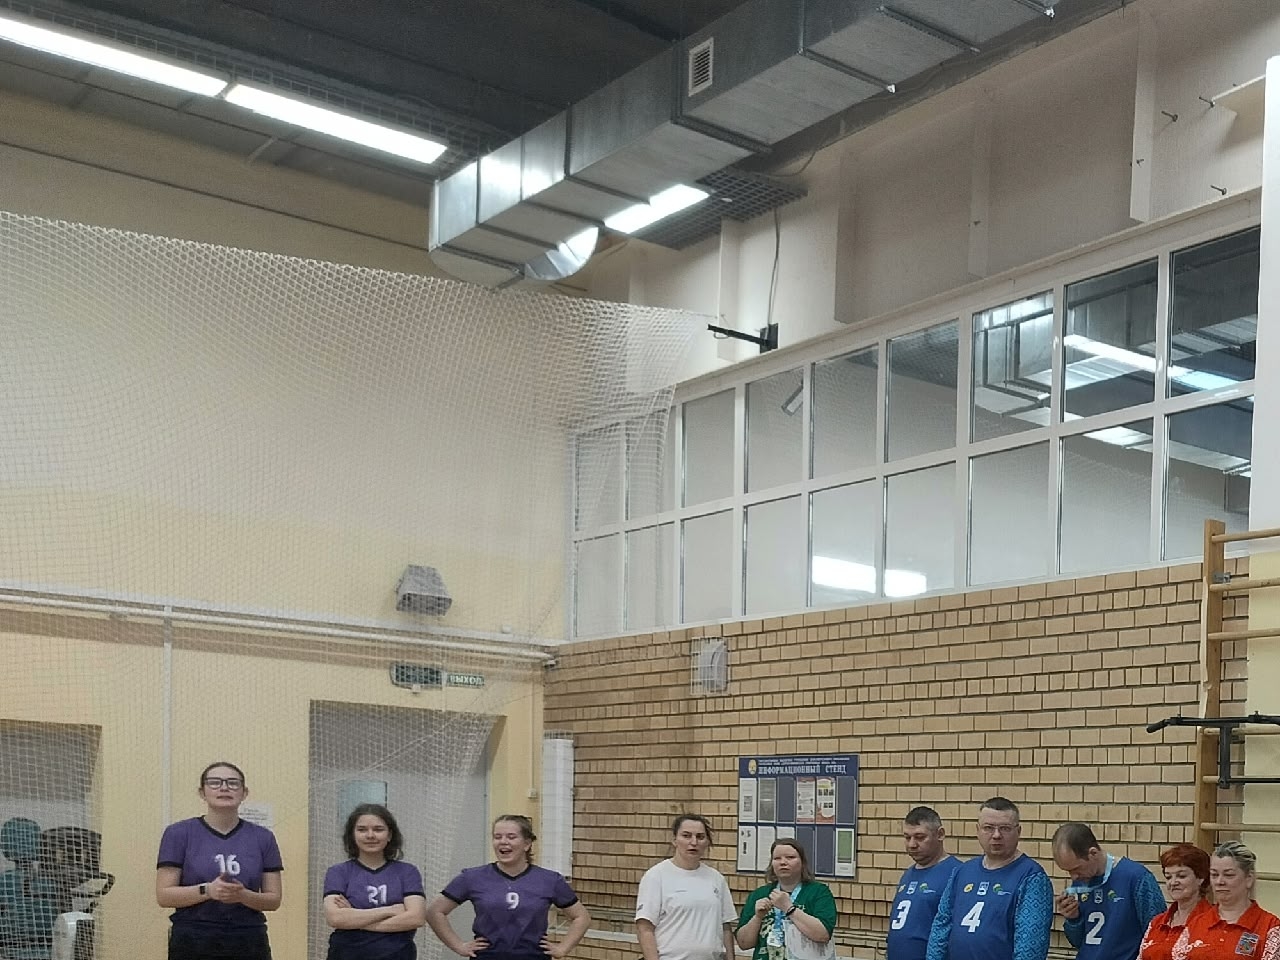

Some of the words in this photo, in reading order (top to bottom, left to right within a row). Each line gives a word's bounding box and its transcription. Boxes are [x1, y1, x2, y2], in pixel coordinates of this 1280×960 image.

[450, 675, 483, 685] ВЫХОД
[758, 764, 820, 775] ИНФОРМАЦИОННЫЙ
[825, 764, 847, 775] СТЕНД
[214, 853, 241, 876] 16
[366, 884, 388, 905] 21
[505, 892, 520, 910] 9
[891, 899, 912, 930] 3
[960, 901, 985, 933] 4
[1085, 911, 1106, 945] 2
